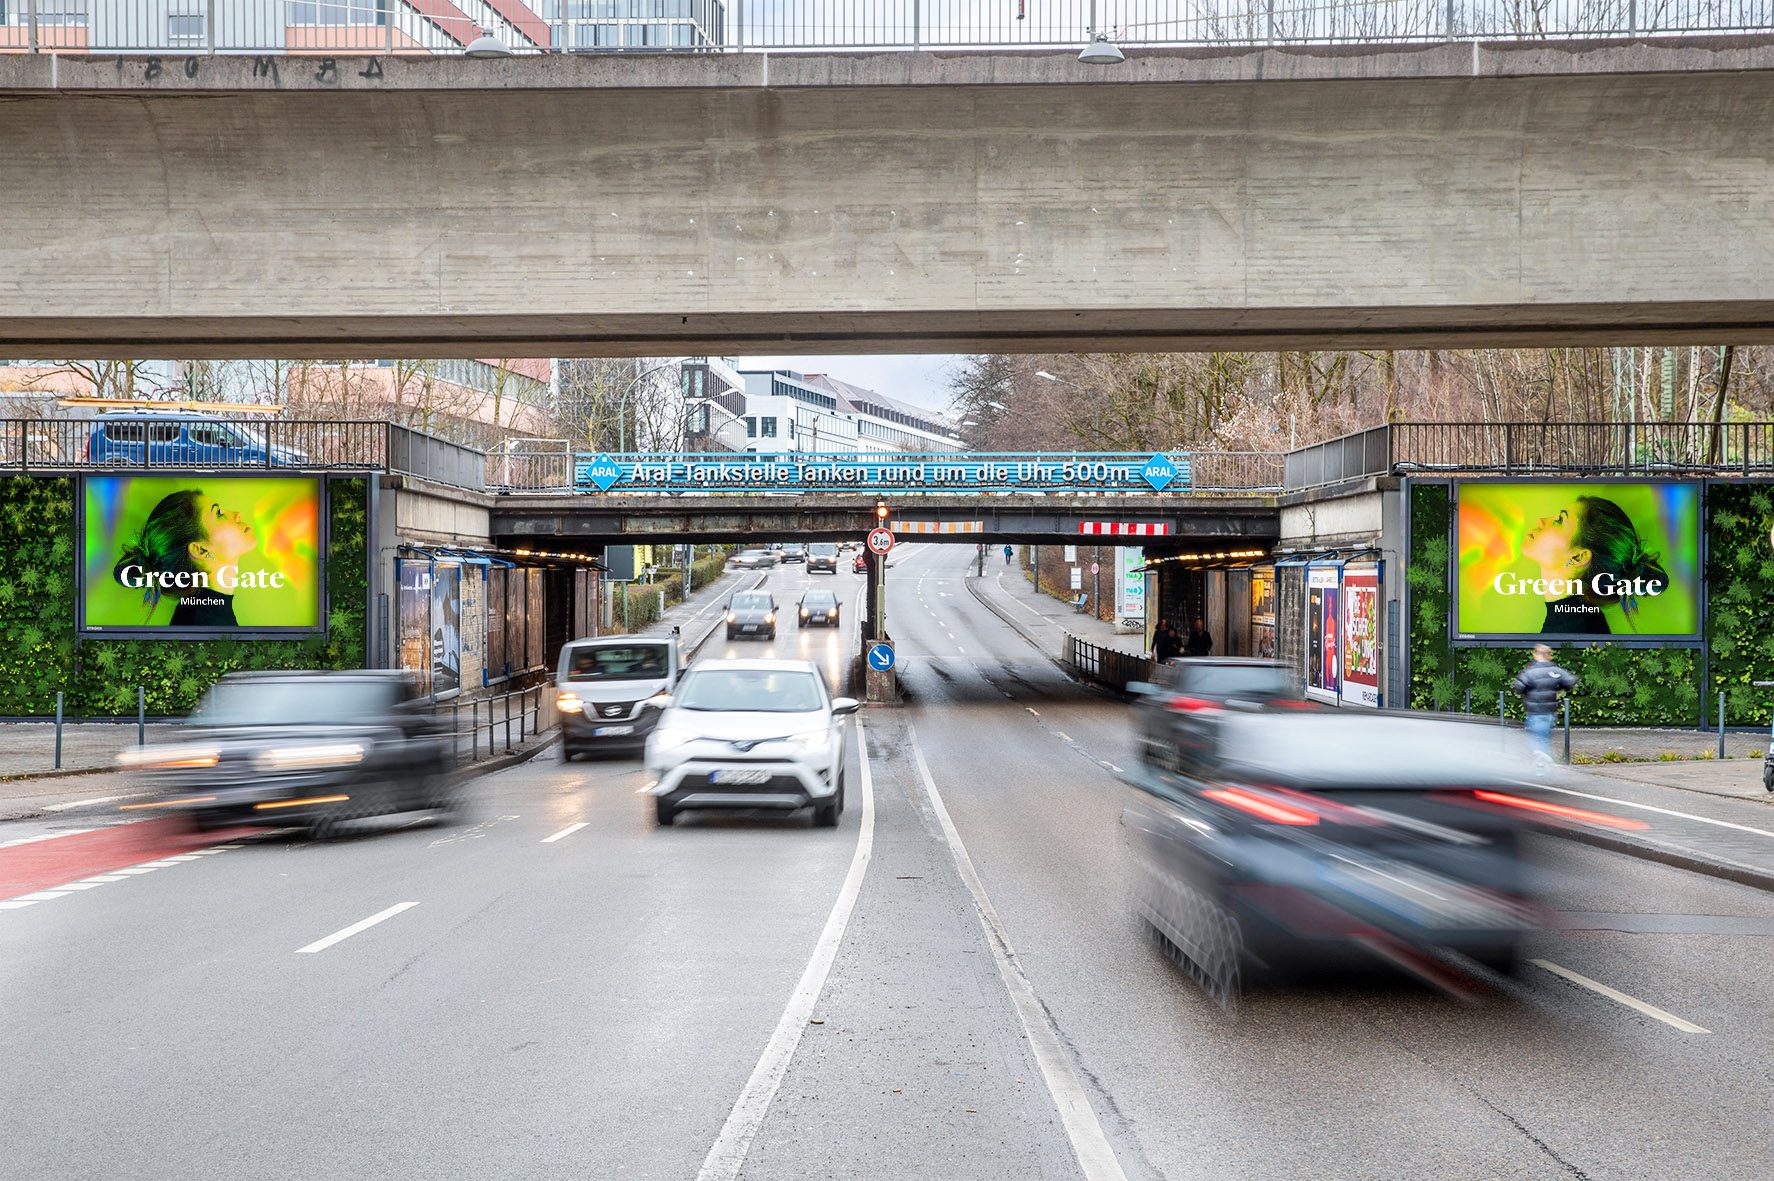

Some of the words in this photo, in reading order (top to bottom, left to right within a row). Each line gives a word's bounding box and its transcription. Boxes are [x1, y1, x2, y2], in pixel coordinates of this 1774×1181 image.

[591, 466, 619, 478] ARAL
[631, 463, 789, 483] Aral-Tankstelle
[794, 463, 869, 482] Tanken
[876, 463, 925, 482] rund
[933, 466, 967, 482] um
[975, 463, 1009, 482] die
[1016, 462, 1057, 482] Uhr
[1062, 462, 1130, 482] 500m
[1145, 466, 1174, 478] ARAL
[120, 565, 210, 588] Green
[216, 565, 285, 588] Gate
[1493, 572, 1585, 595] Green
[1591, 572, 1662, 595] Gate
[180, 596, 225, 606] München
[1554, 603, 1600, 613] München
